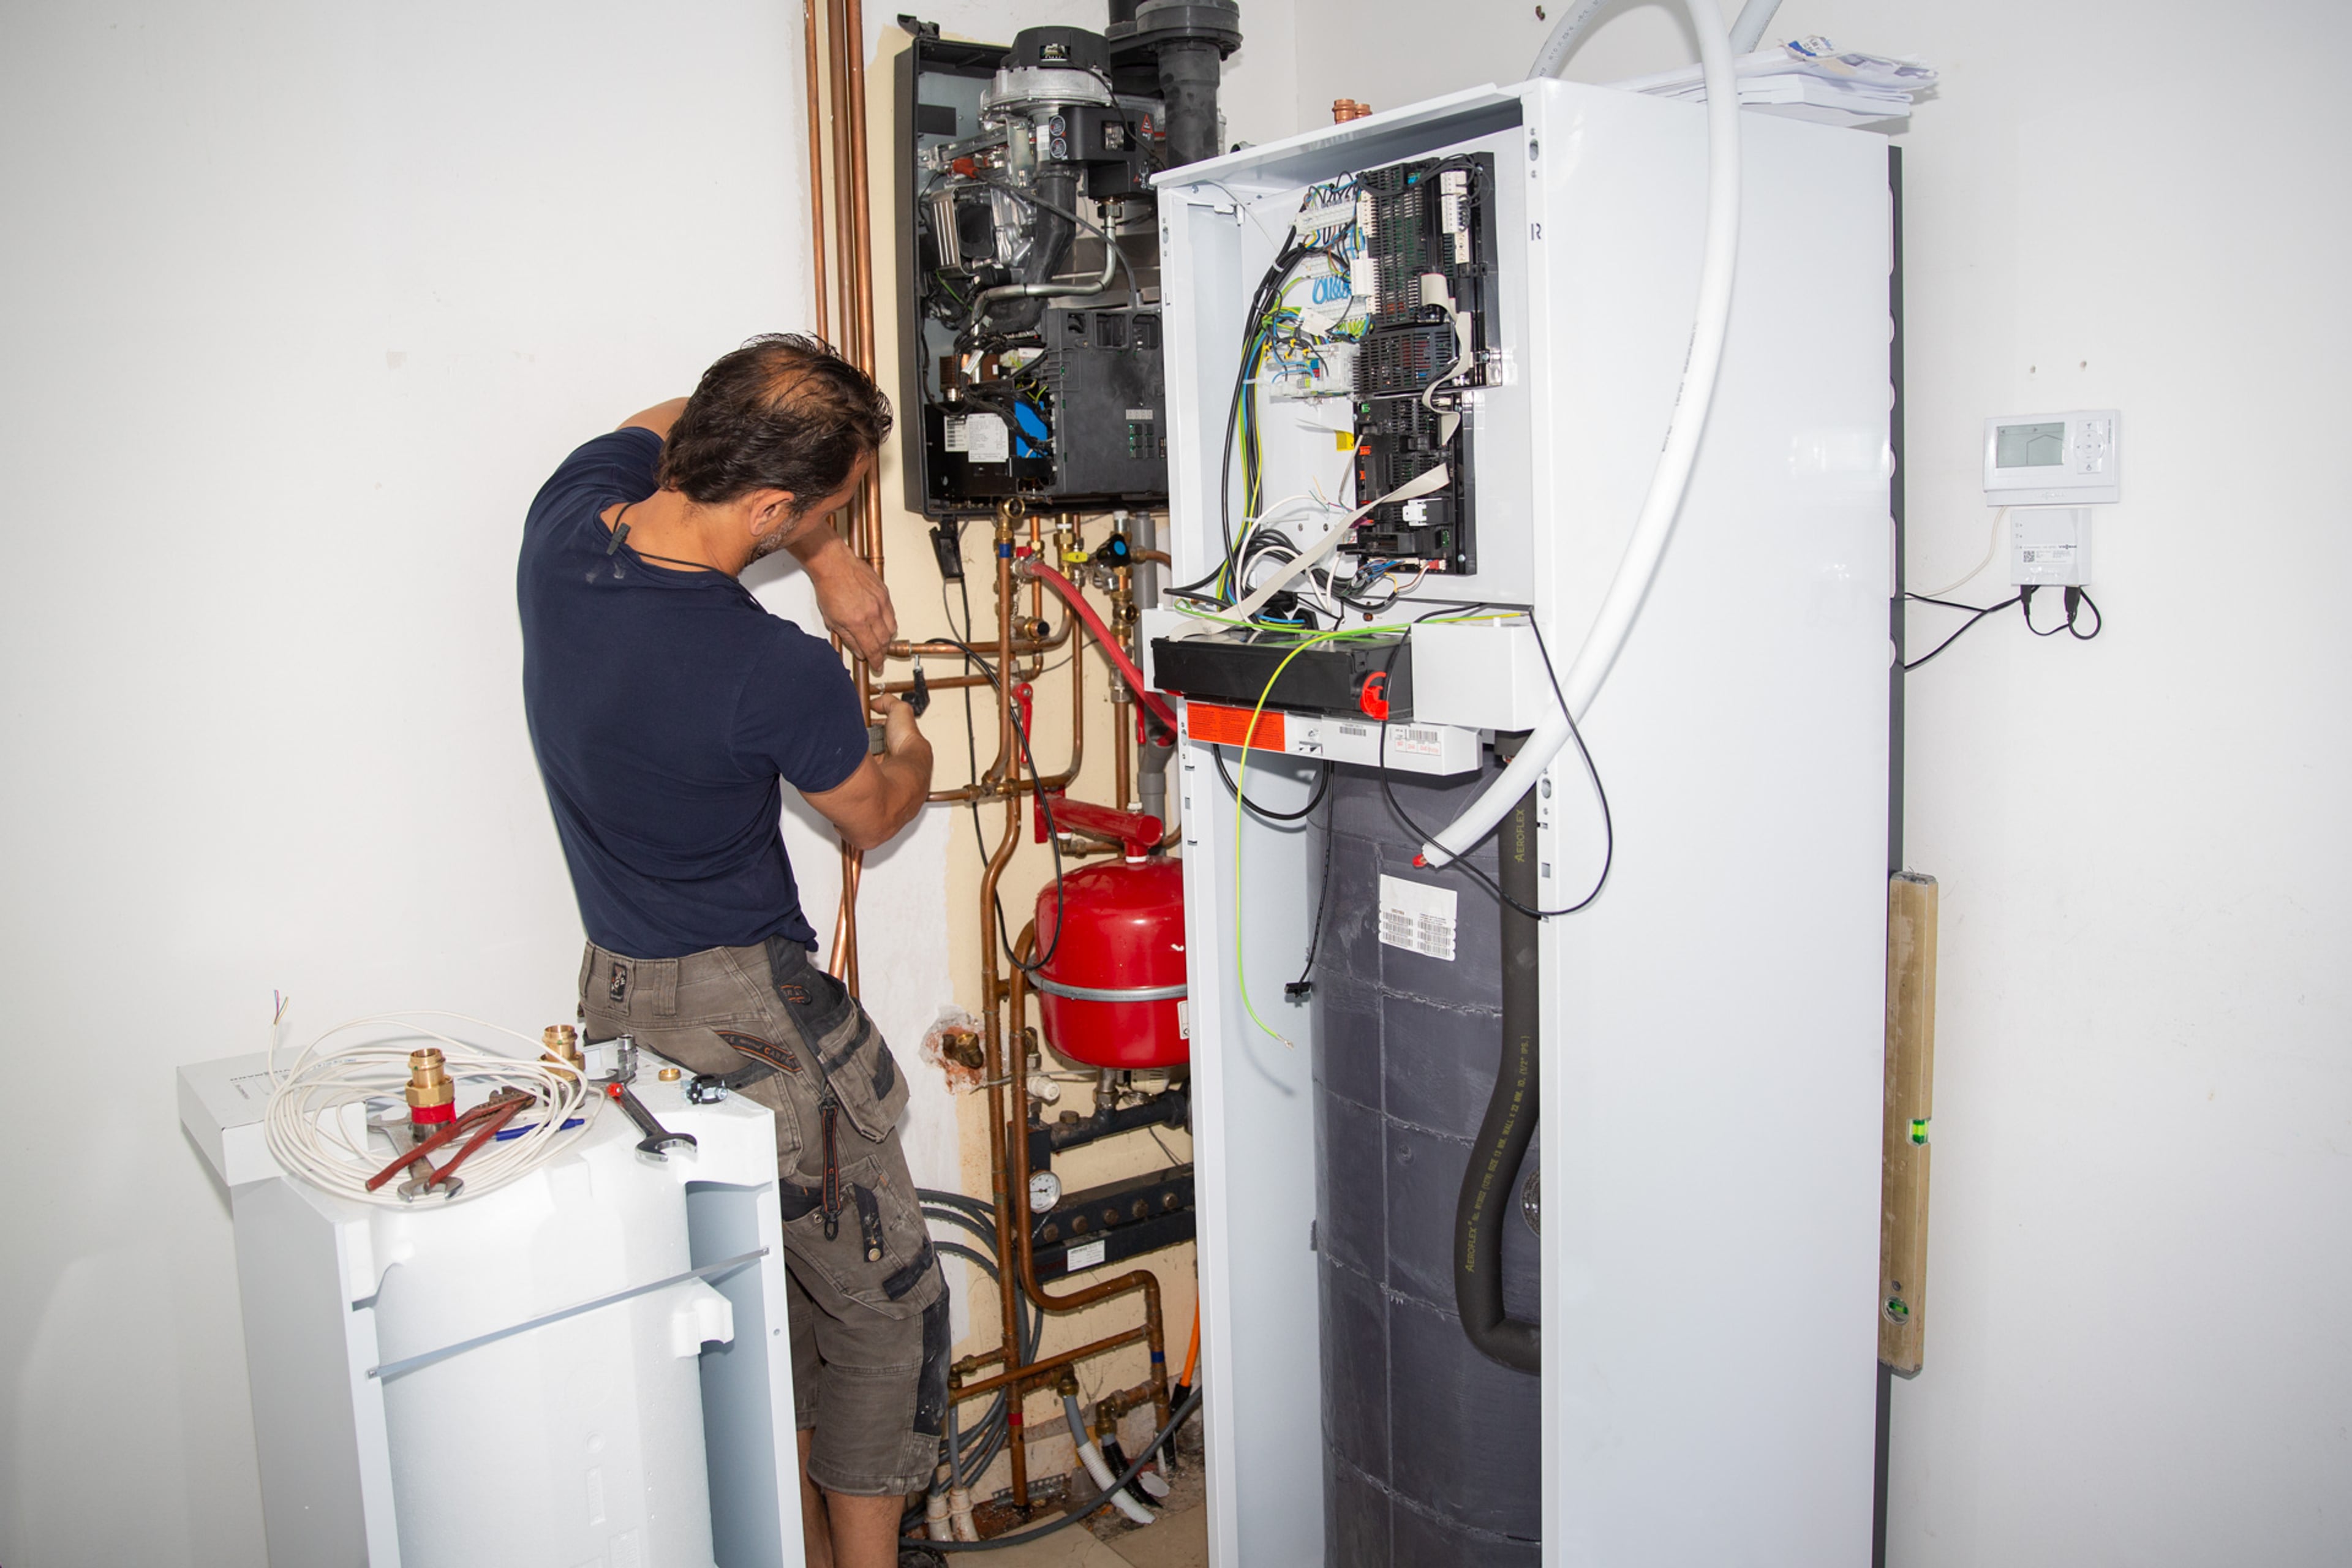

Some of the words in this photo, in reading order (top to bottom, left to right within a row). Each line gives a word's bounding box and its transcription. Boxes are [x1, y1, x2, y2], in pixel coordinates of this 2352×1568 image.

[1513, 809, 1525, 863] AEROFLEX
[1464, 1227, 1477, 1273] AEROFLEX
[1502, 1119, 1515, 1136] WALL
